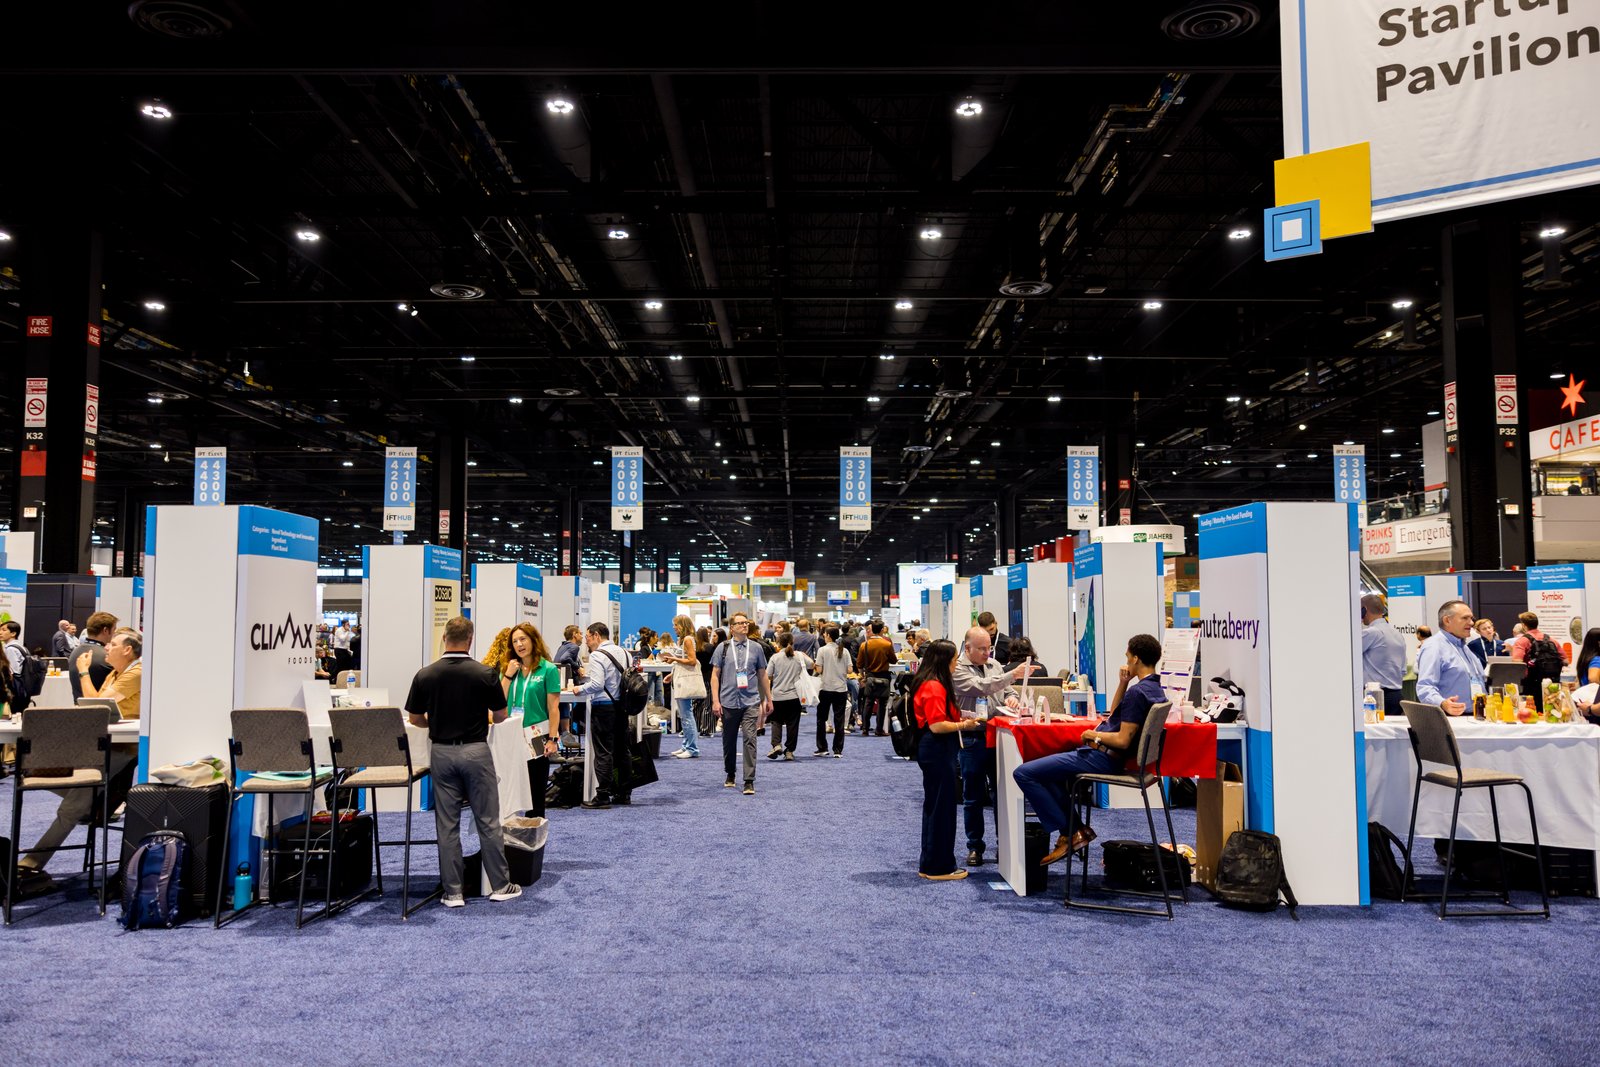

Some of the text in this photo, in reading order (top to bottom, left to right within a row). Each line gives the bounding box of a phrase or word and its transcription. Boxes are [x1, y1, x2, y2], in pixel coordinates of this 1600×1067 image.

[1376, 26, 1600, 102] Pavilion
[85, 438, 95, 446] K32
[1366, 526, 1393, 541] DRINKS
[1369, 542, 1390, 555] FOOD
[1542, 592, 1564, 603] Symbio
[251, 612, 312, 650] CLIMAX
[1200, 612, 1259, 649] nutraberry
